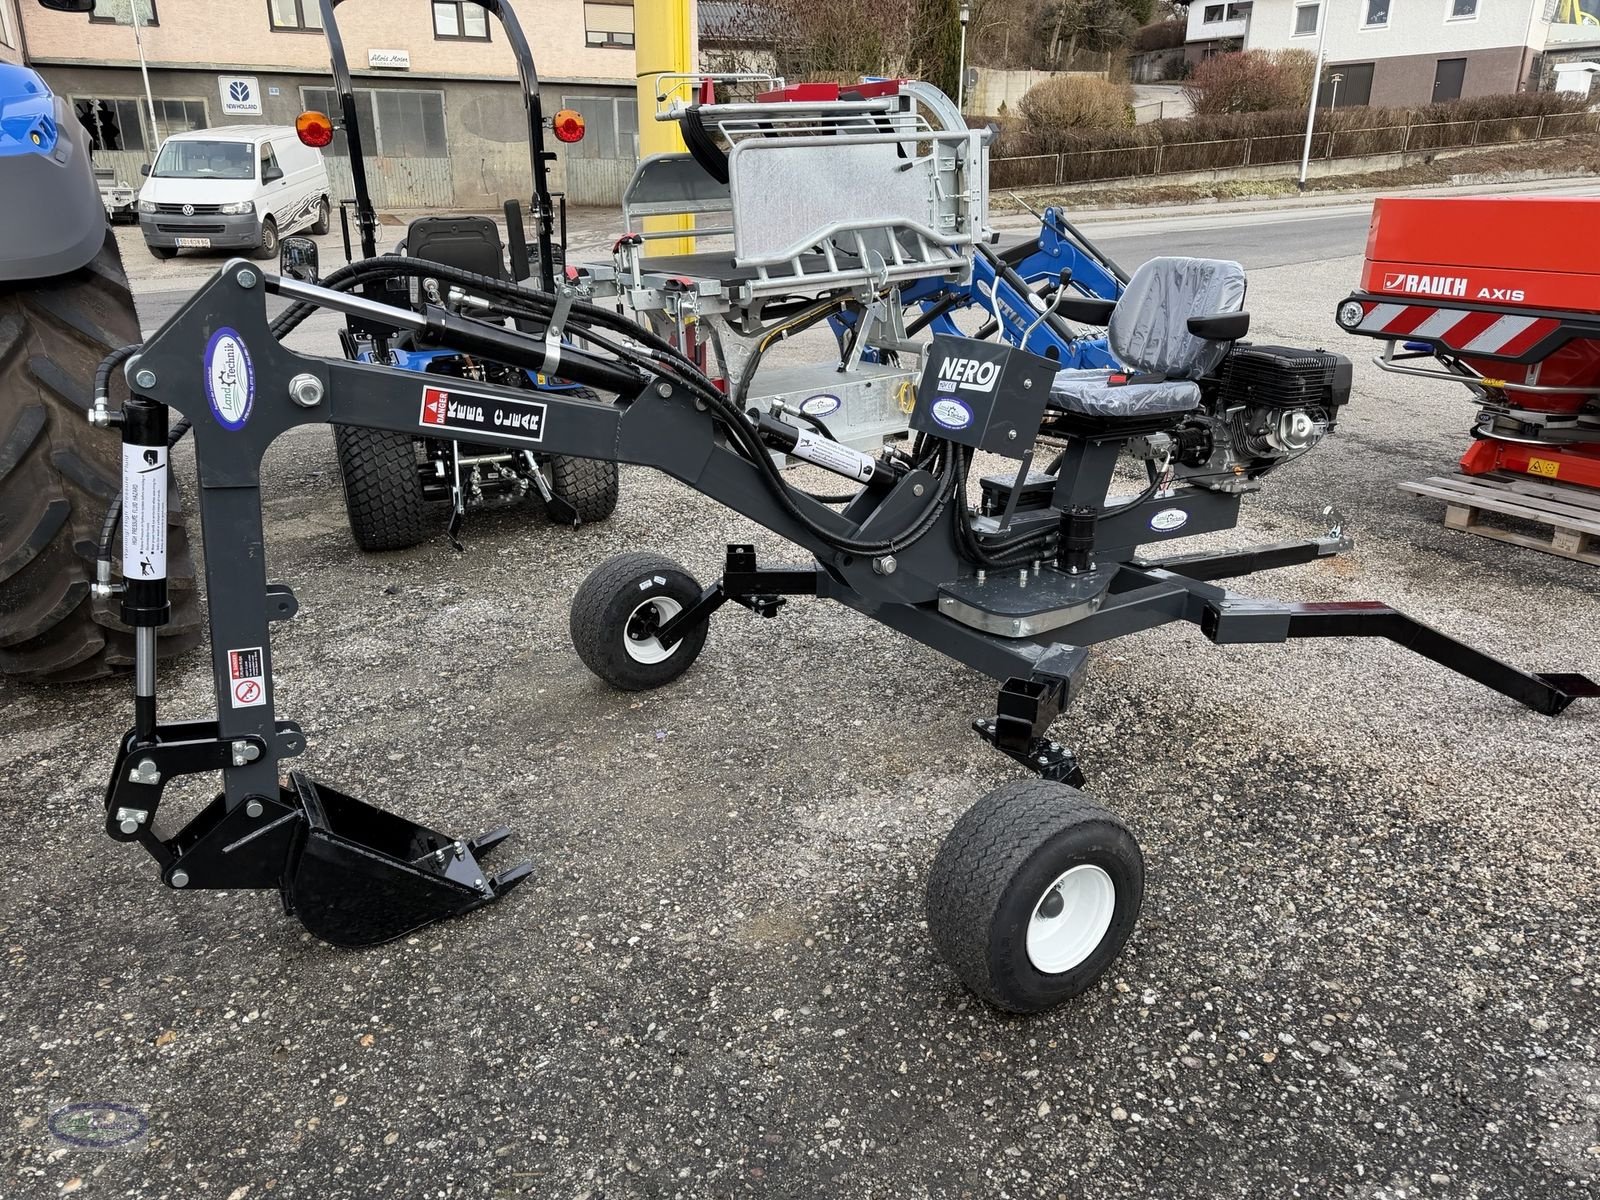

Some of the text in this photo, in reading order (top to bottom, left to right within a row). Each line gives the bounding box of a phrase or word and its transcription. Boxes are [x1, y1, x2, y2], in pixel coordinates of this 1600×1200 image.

[1405, 274, 1525, 302] RAUCH AXIS
[222, 342, 236, 411] Land Technik
[938, 356, 995, 385] NERO
[436, 392, 449, 424] DANGER
[447, 400, 540, 431] KEEP CLEAR
